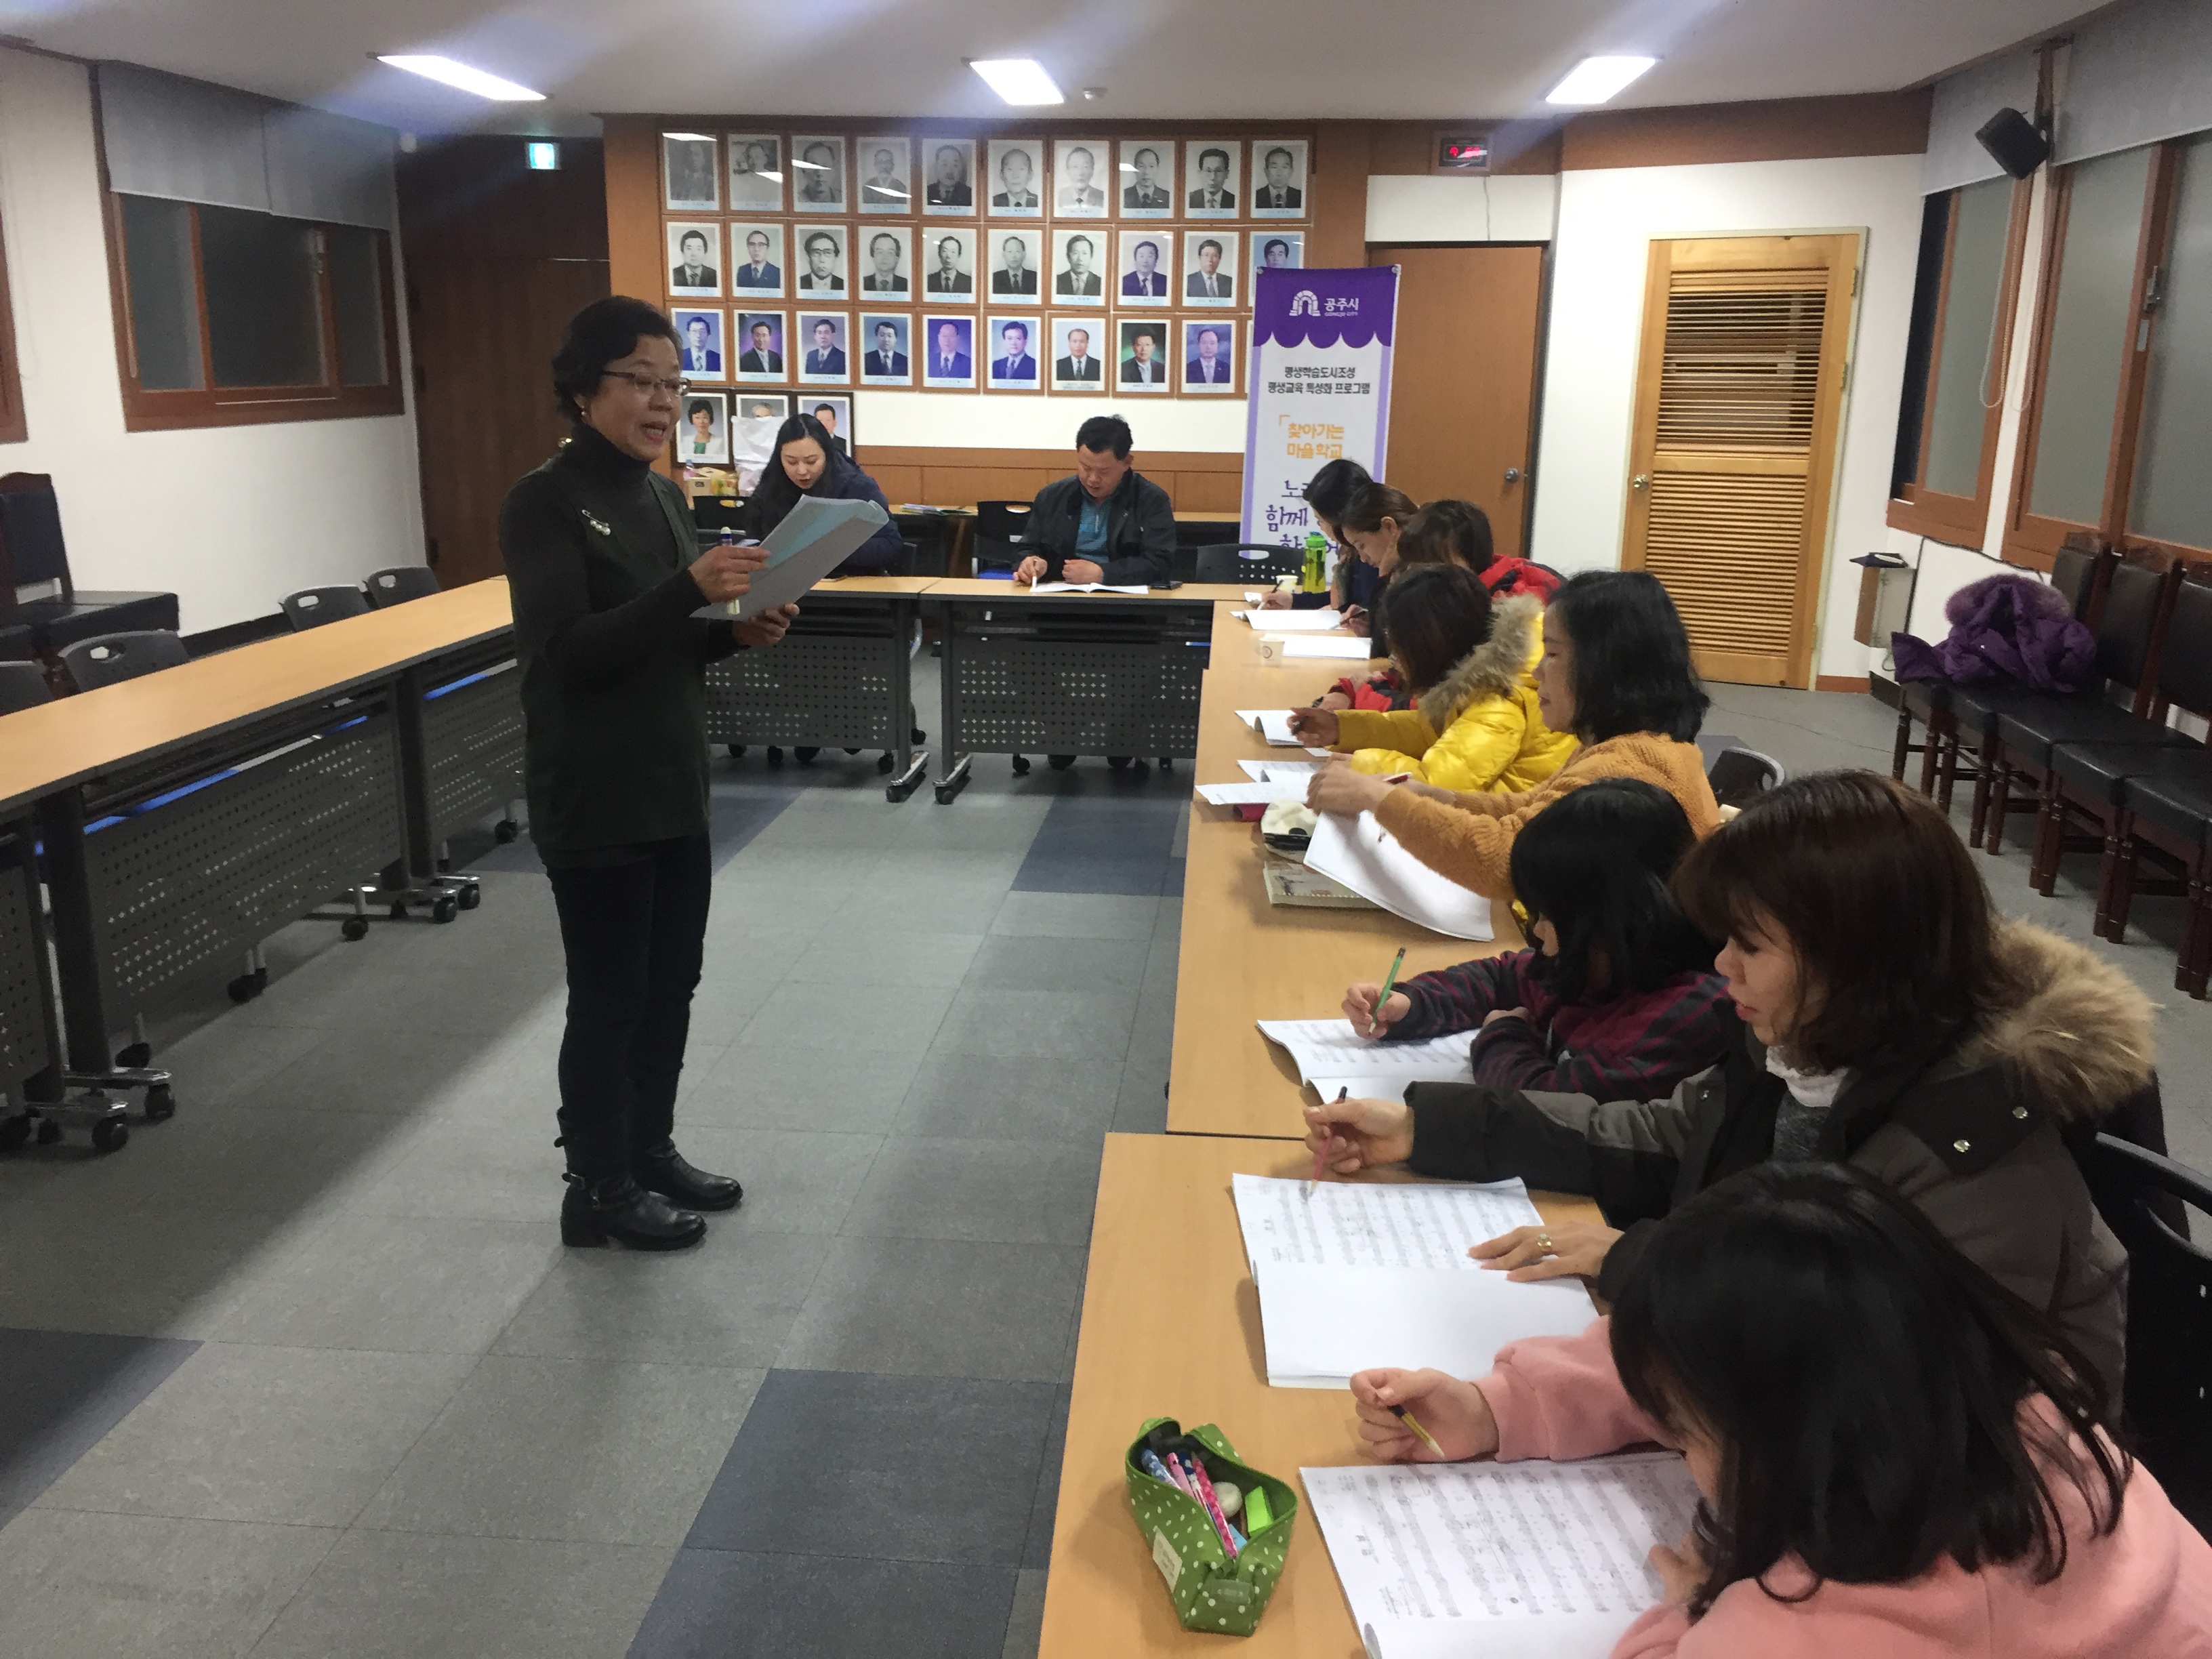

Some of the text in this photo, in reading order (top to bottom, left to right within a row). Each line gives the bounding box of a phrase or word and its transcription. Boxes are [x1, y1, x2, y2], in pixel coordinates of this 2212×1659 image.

[1324, 298, 1359, 312] 공주시
[1268, 382, 1370, 394] 평생교육 특성화 프로그램
[1265, 504, 1308, 532] 함께
